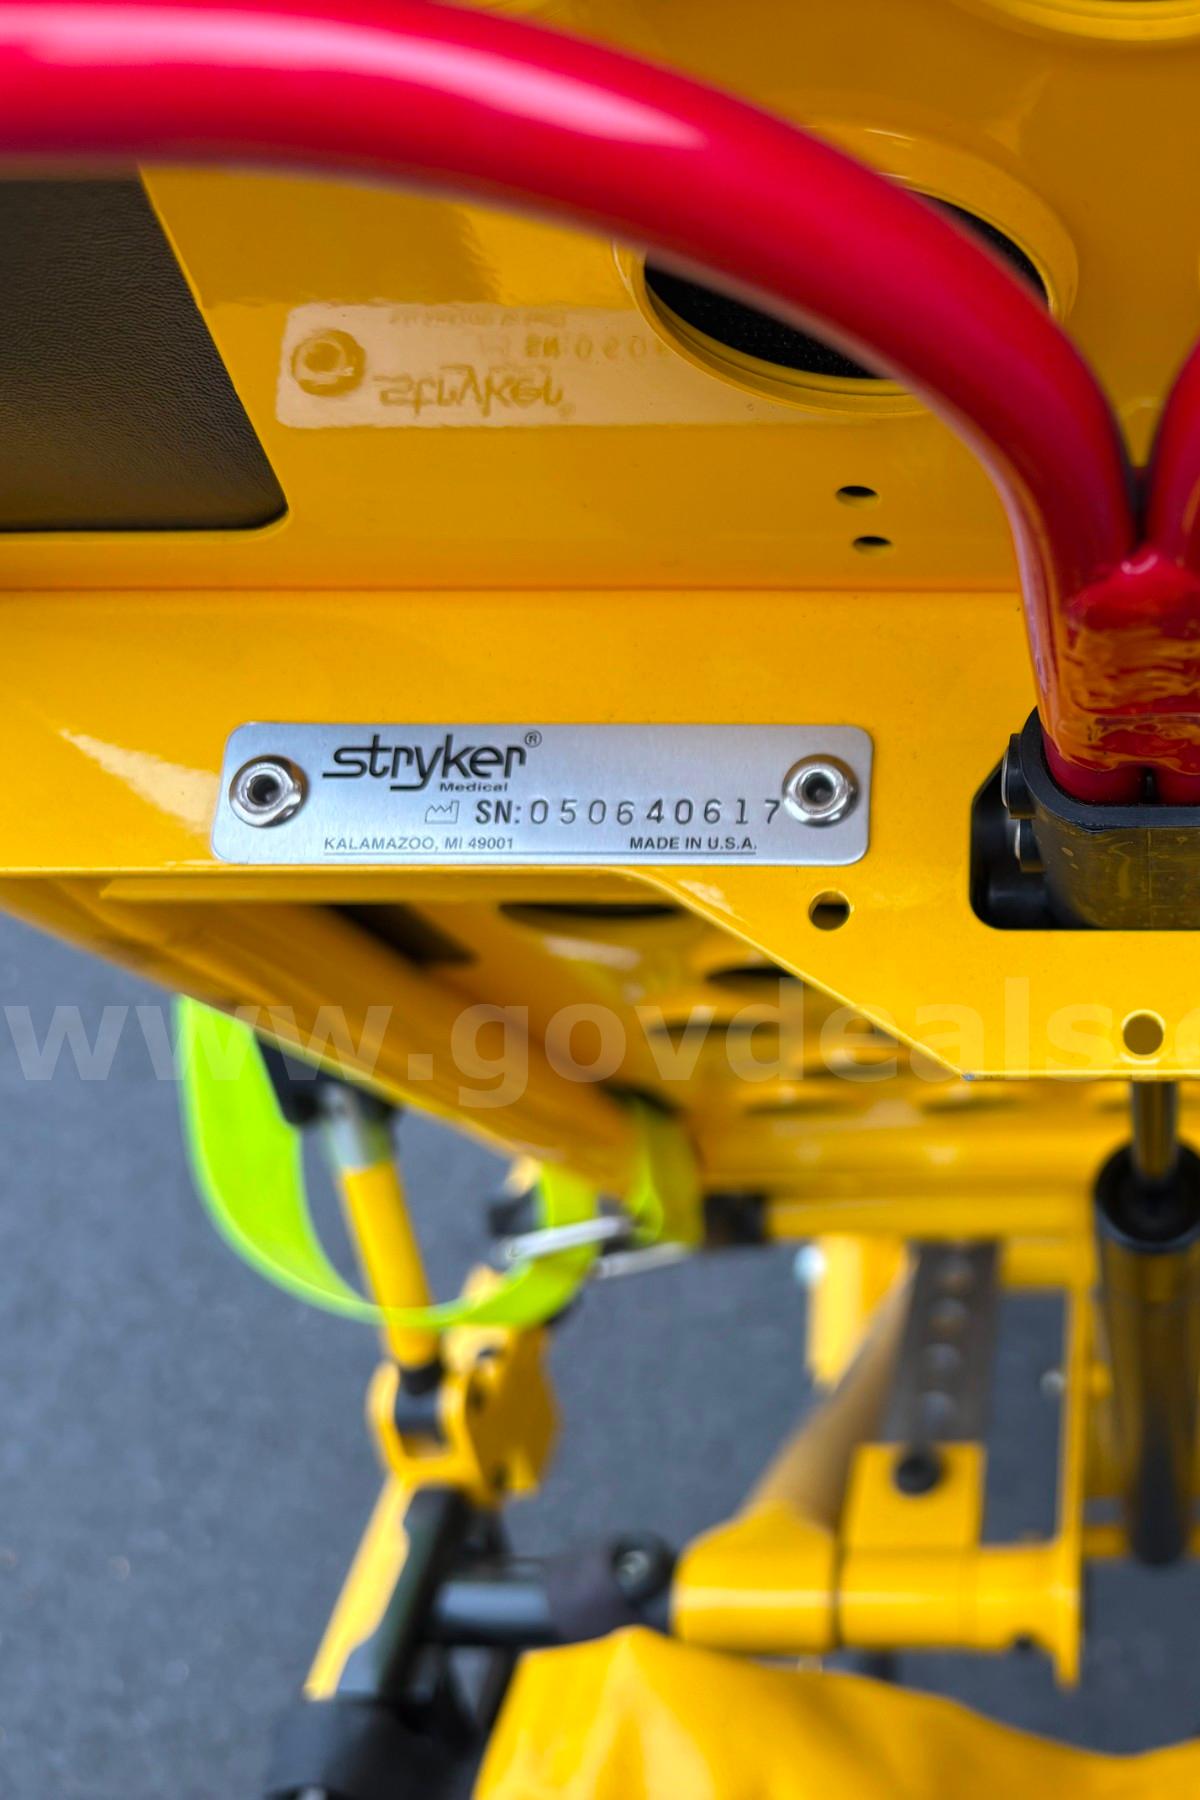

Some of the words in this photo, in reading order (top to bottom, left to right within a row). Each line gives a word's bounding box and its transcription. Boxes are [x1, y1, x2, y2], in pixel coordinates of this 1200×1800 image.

[439, 782, 508, 793] Medical
[324, 837, 440, 851] KALAMAZOO,
[445, 837, 463, 850] MI
[468, 837, 514, 850] 49001
[630, 837, 680, 849] MADE
[686, 837, 702, 849] IN
[708, 837, 757, 849] U.S.A.
